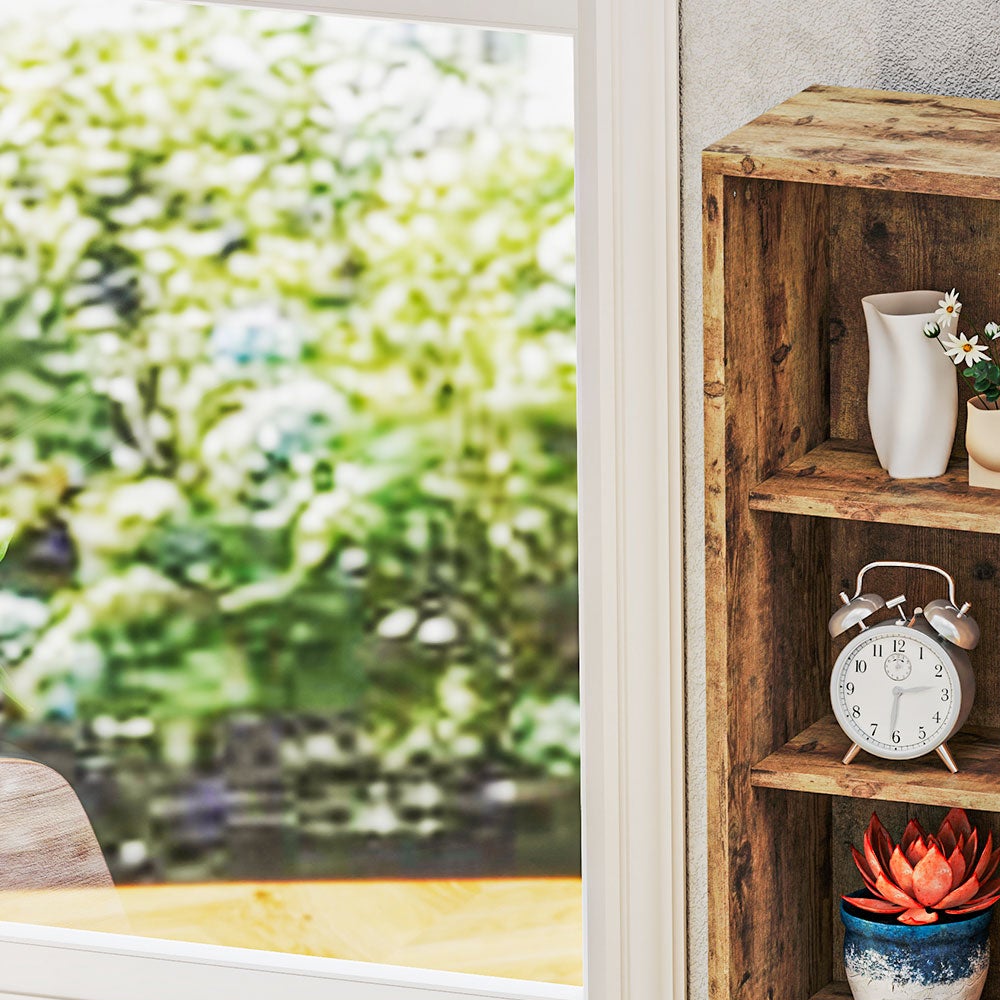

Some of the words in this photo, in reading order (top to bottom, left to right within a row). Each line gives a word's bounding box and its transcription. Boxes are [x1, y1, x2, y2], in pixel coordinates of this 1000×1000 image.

[873, 644, 883, 657] 11
[893, 639, 906, 653] 12
[919, 646, 924, 660] 1
[855, 659, 867, 673] 10
[934, 664, 943, 678] 2
[846, 682, 855, 695] 9
[940, 688, 950, 702] 3
[852, 705, 861, 719] 8
[932, 711, 942, 724] 4
[870, 723, 879, 736] 7
[918, 726, 927, 740] 5
[891, 730, 901, 744] 6
